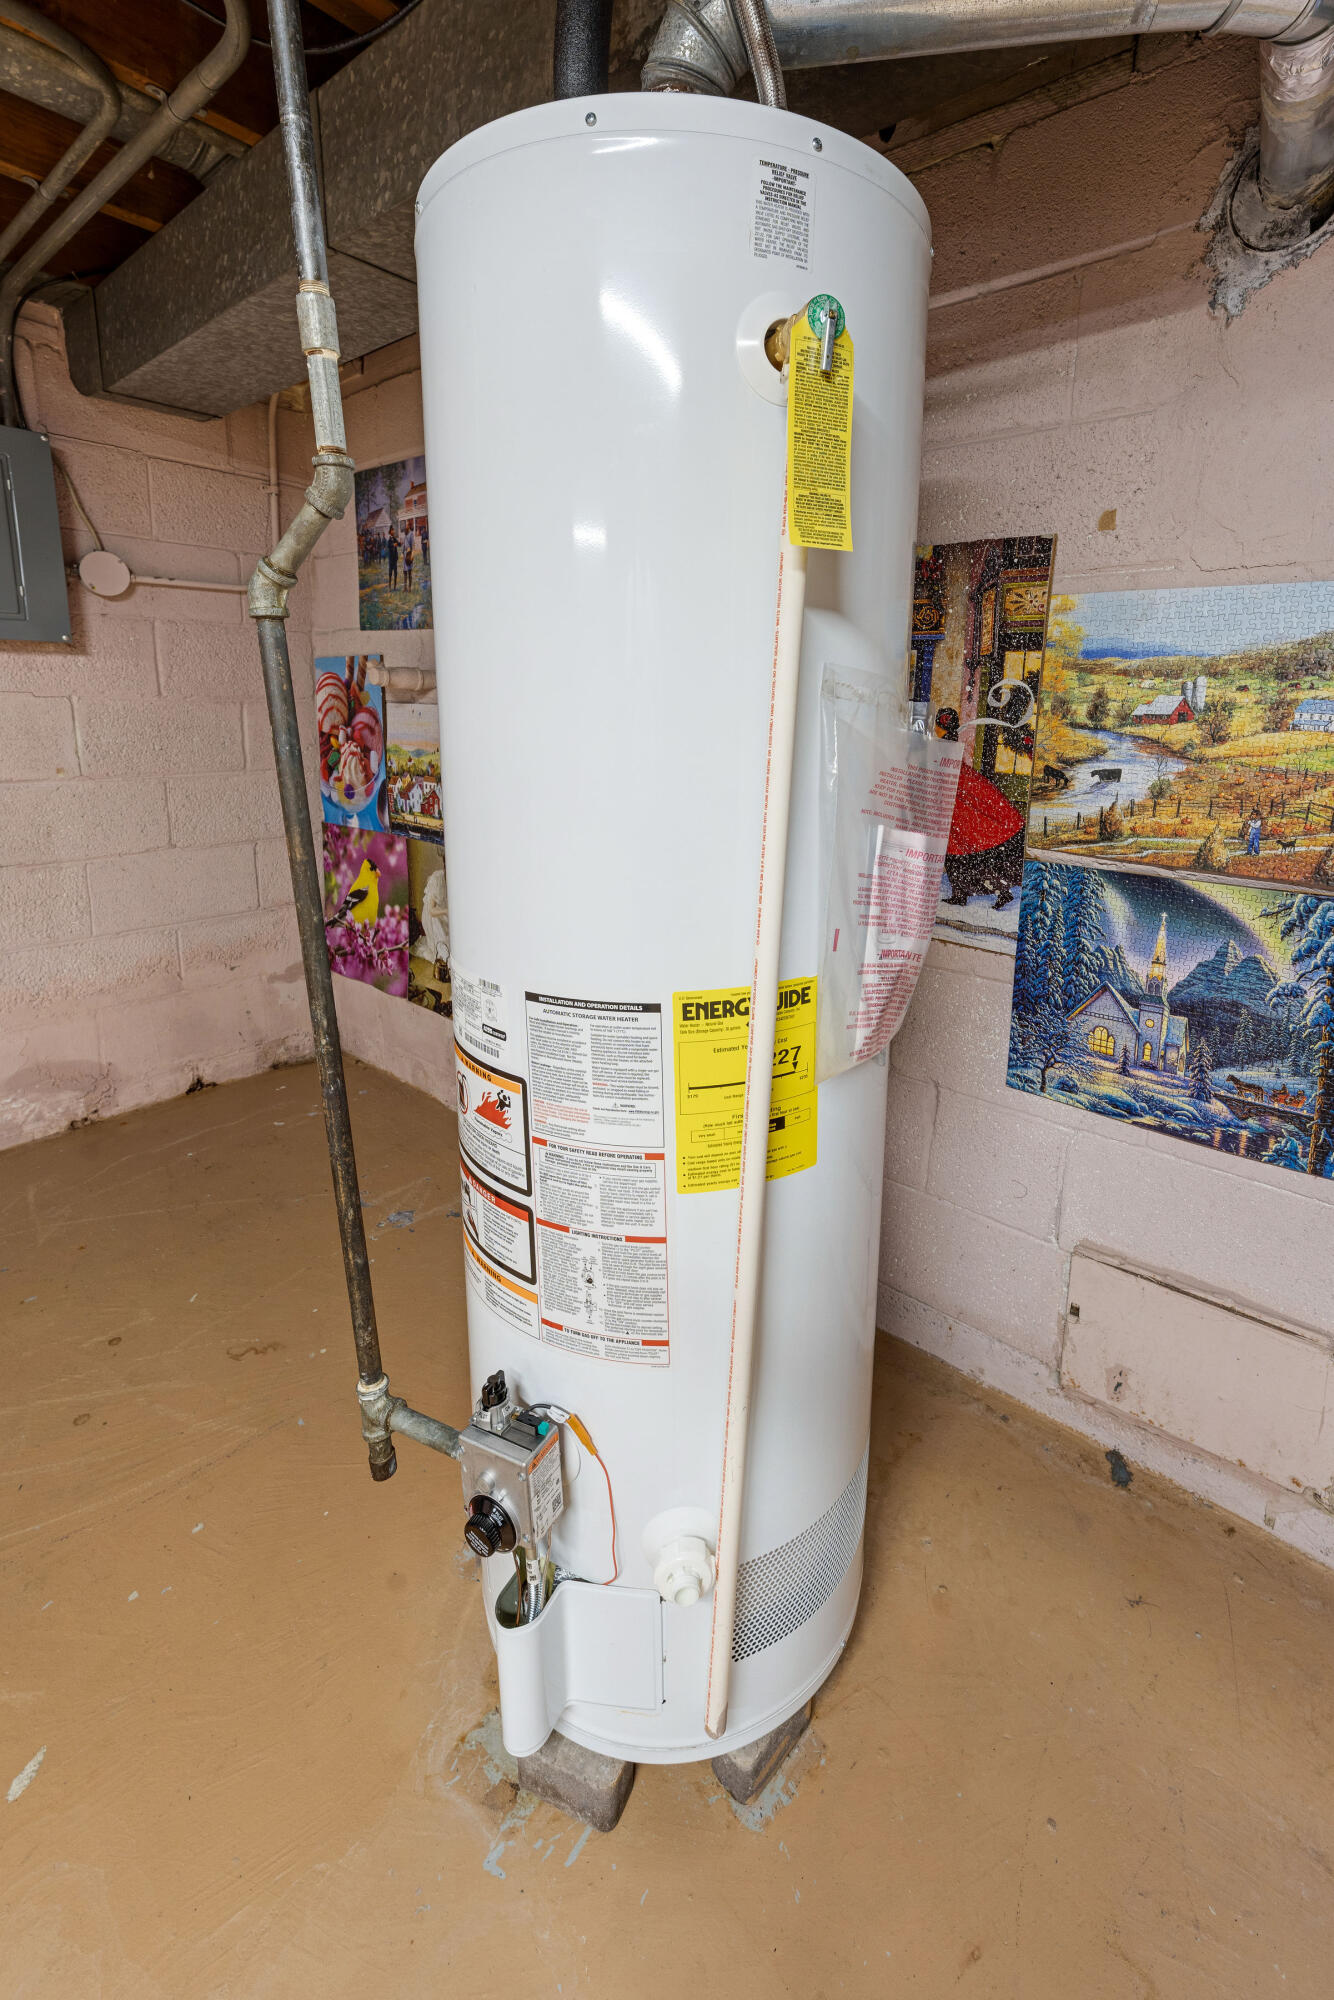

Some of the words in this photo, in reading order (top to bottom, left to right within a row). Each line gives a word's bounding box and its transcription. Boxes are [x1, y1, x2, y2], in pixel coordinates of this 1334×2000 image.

[759, 160, 788, 172] TEMPERATURE
[790, 167, 809, 179] PRESSURE
[771, 169, 785, 178] RELIEF
[785, 172, 798, 181] VALVE
[761, 180, 775, 188] FOLLOW
[783, 184, 807, 196] MAINTENANCE
[764, 196, 788, 206] INSTRUCTION
[788, 201, 802, 210] MANUAL
[538, 996, 574, 1006] INSTALLATION
[586, 1002, 618, 1010] OPERATION
[543, 1008, 572, 1017] AUTOMATIC
[713, 1045, 740, 1054] Estimated
[464, 1060, 492, 1082] WARNING
[569, 1147, 585, 1155] SAFETY
[472, 1180, 496, 1204] DANGER
[571, 1229, 591, 1238] LIGHTING
[591, 1233, 623, 1242] INSTRUCTIONS
[476, 1256, 502, 1283] WARNING
